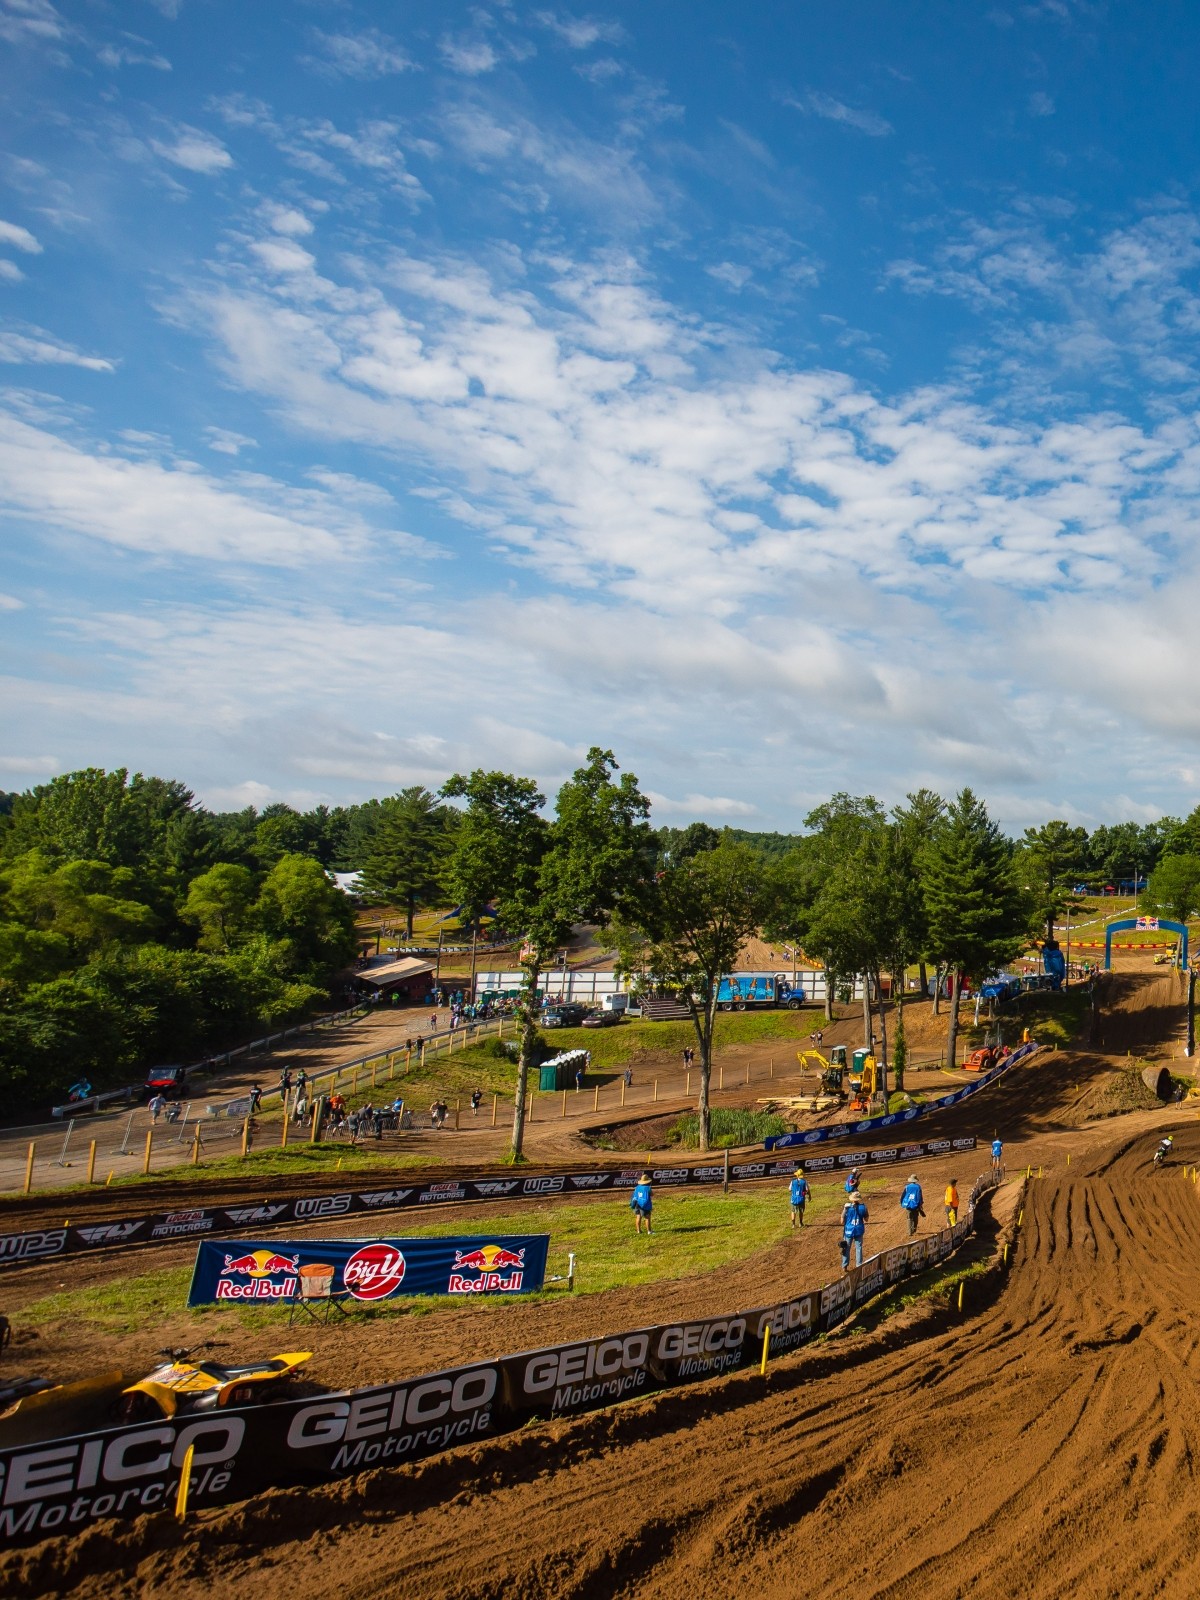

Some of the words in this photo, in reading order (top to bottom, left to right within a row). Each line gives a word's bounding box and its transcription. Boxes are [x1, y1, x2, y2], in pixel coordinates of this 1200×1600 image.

[928, 1140, 950, 1150] GEICO
[953, 1138, 975, 1146] GEICO
[805, 1157, 834, 1167] GEICO
[838, 1153, 867, 1163] GEICO
[871, 1149, 897, 1159] GEICO
[653, 1169, 689, 1179] GEICO
[693, 1166, 725, 1177] GEICO
[732, 1164, 765, 1174] GEICO
[430, 1184, 449, 1192] LUCAS
[473, 1181, 519, 1193] FLY
[523, 1176, 566, 1193] WPS
[358, 1189, 414, 1204] FLY
[419, 1191, 466, 1202] MOTOCROSS
[225, 1204, 288, 1221] FLY
[294, 1194, 352, 1218] WPS
[167, 1214, 189, 1223] LUCAS
[76, 1221, 146, 1242] FLY
[152, 1220, 213, 1236] MOTOCROSS
[344, 1260, 380, 1286] Big
[216, 1278, 255, 1299] Red
[256, 1277, 297, 1299] Bull
[448, 1273, 486, 1293] Red
[487, 1271, 523, 1292] Bull
[757, 1297, 812, 1339] GEICO
[658, 1318, 746, 1360] GEICO
[769, 1325, 812, 1350] Motorcycle
[523, 1334, 649, 1393] GEICO
[678, 1350, 742, 1377] Motorcycle
[552, 1369, 645, 1410] Motorcycle
[287, 1368, 497, 1448] GEICO
[331, 1410, 491, 1470] Motorcycle
[0, 1416, 246, 1505] EICO
